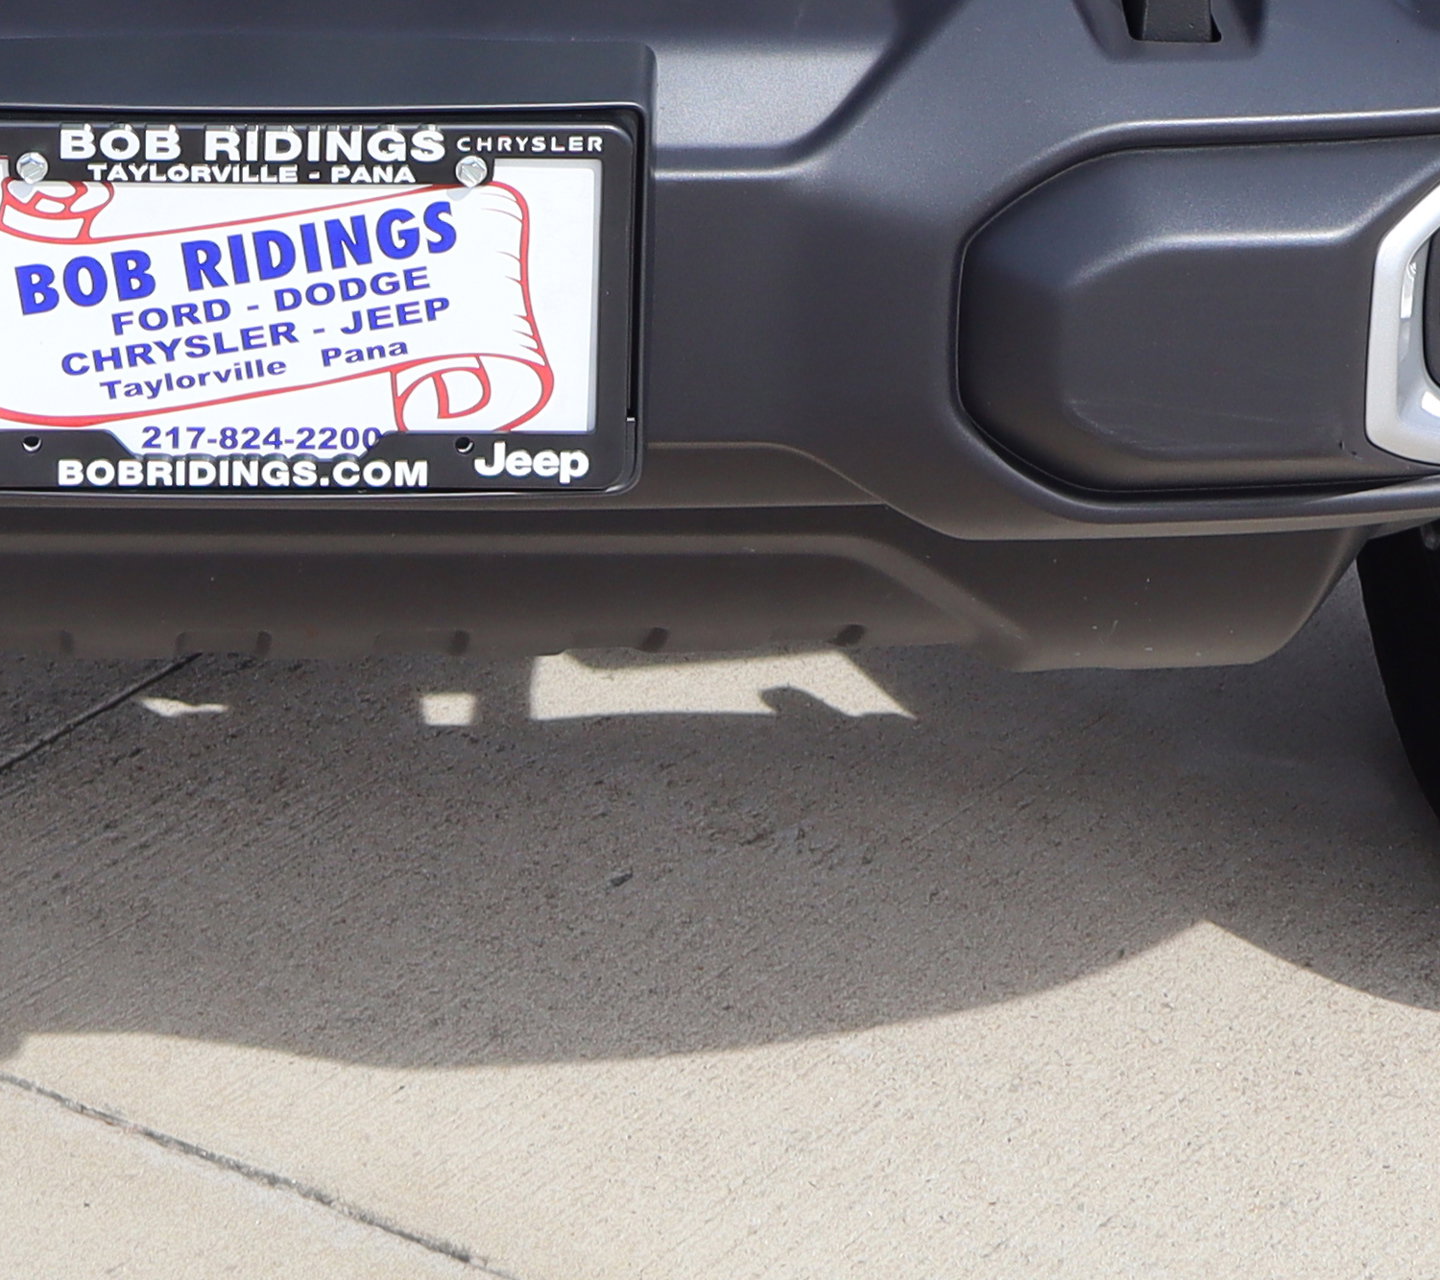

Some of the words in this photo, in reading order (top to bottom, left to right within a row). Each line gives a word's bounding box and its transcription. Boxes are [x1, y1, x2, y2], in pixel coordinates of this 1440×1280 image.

[59, 125, 183, 161] BOB
[204, 125, 446, 163] RIDINGS
[455, 135, 603, 154] CHRYSLER
[87, 162, 298, 184] TAYLORVILLE
[330, 163, 416, 184] PANA
[15, 249, 156, 316] BOB
[181, 200, 458, 292] RIDINGS
[111, 298, 232, 336] FORD
[273, 266, 431, 313] DODGE
[61, 321, 300, 376] CHRYSLER
[339, 297, 451, 335] JEEP
[99, 358, 287, 400] Taylorville
[321, 341, 409, 368] Pana
[141, 426, 382, 451] 217-824-2200
[57, 458, 429, 488] BOBRIDINGS.COM
[473, 441, 590, 484] Jeep
